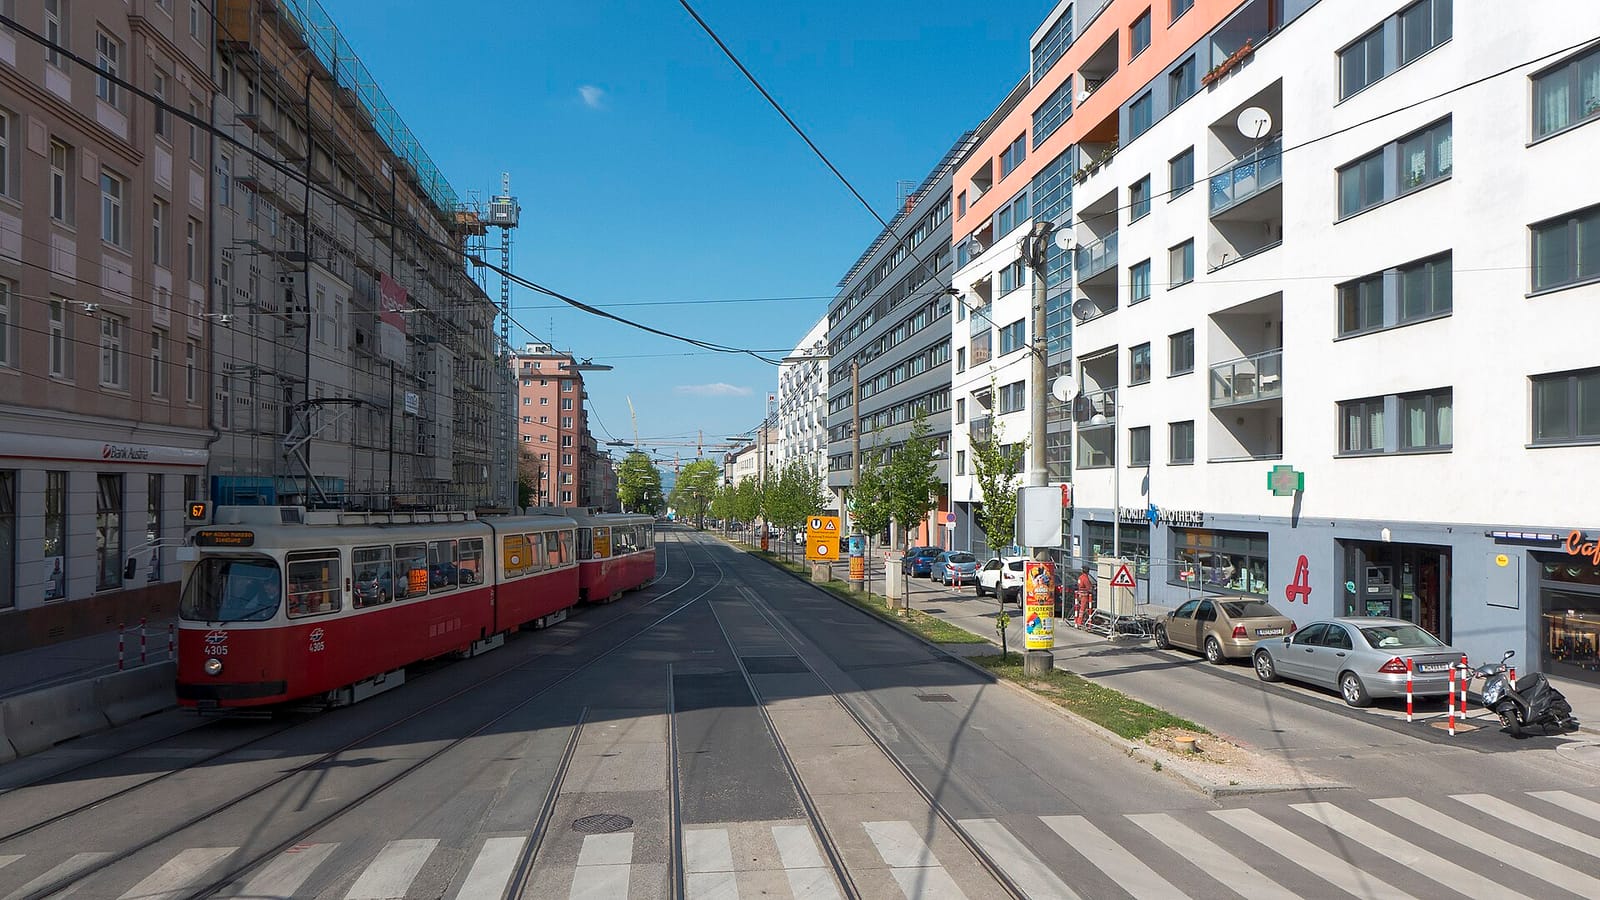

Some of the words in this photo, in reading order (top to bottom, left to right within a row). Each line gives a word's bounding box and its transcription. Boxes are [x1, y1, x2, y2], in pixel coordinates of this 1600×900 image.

[110, 445, 127, 459] Bank
[192, 505, 204, 517] 67
[204, 645, 228, 655] 4305
[309, 642, 325, 653] 4305
